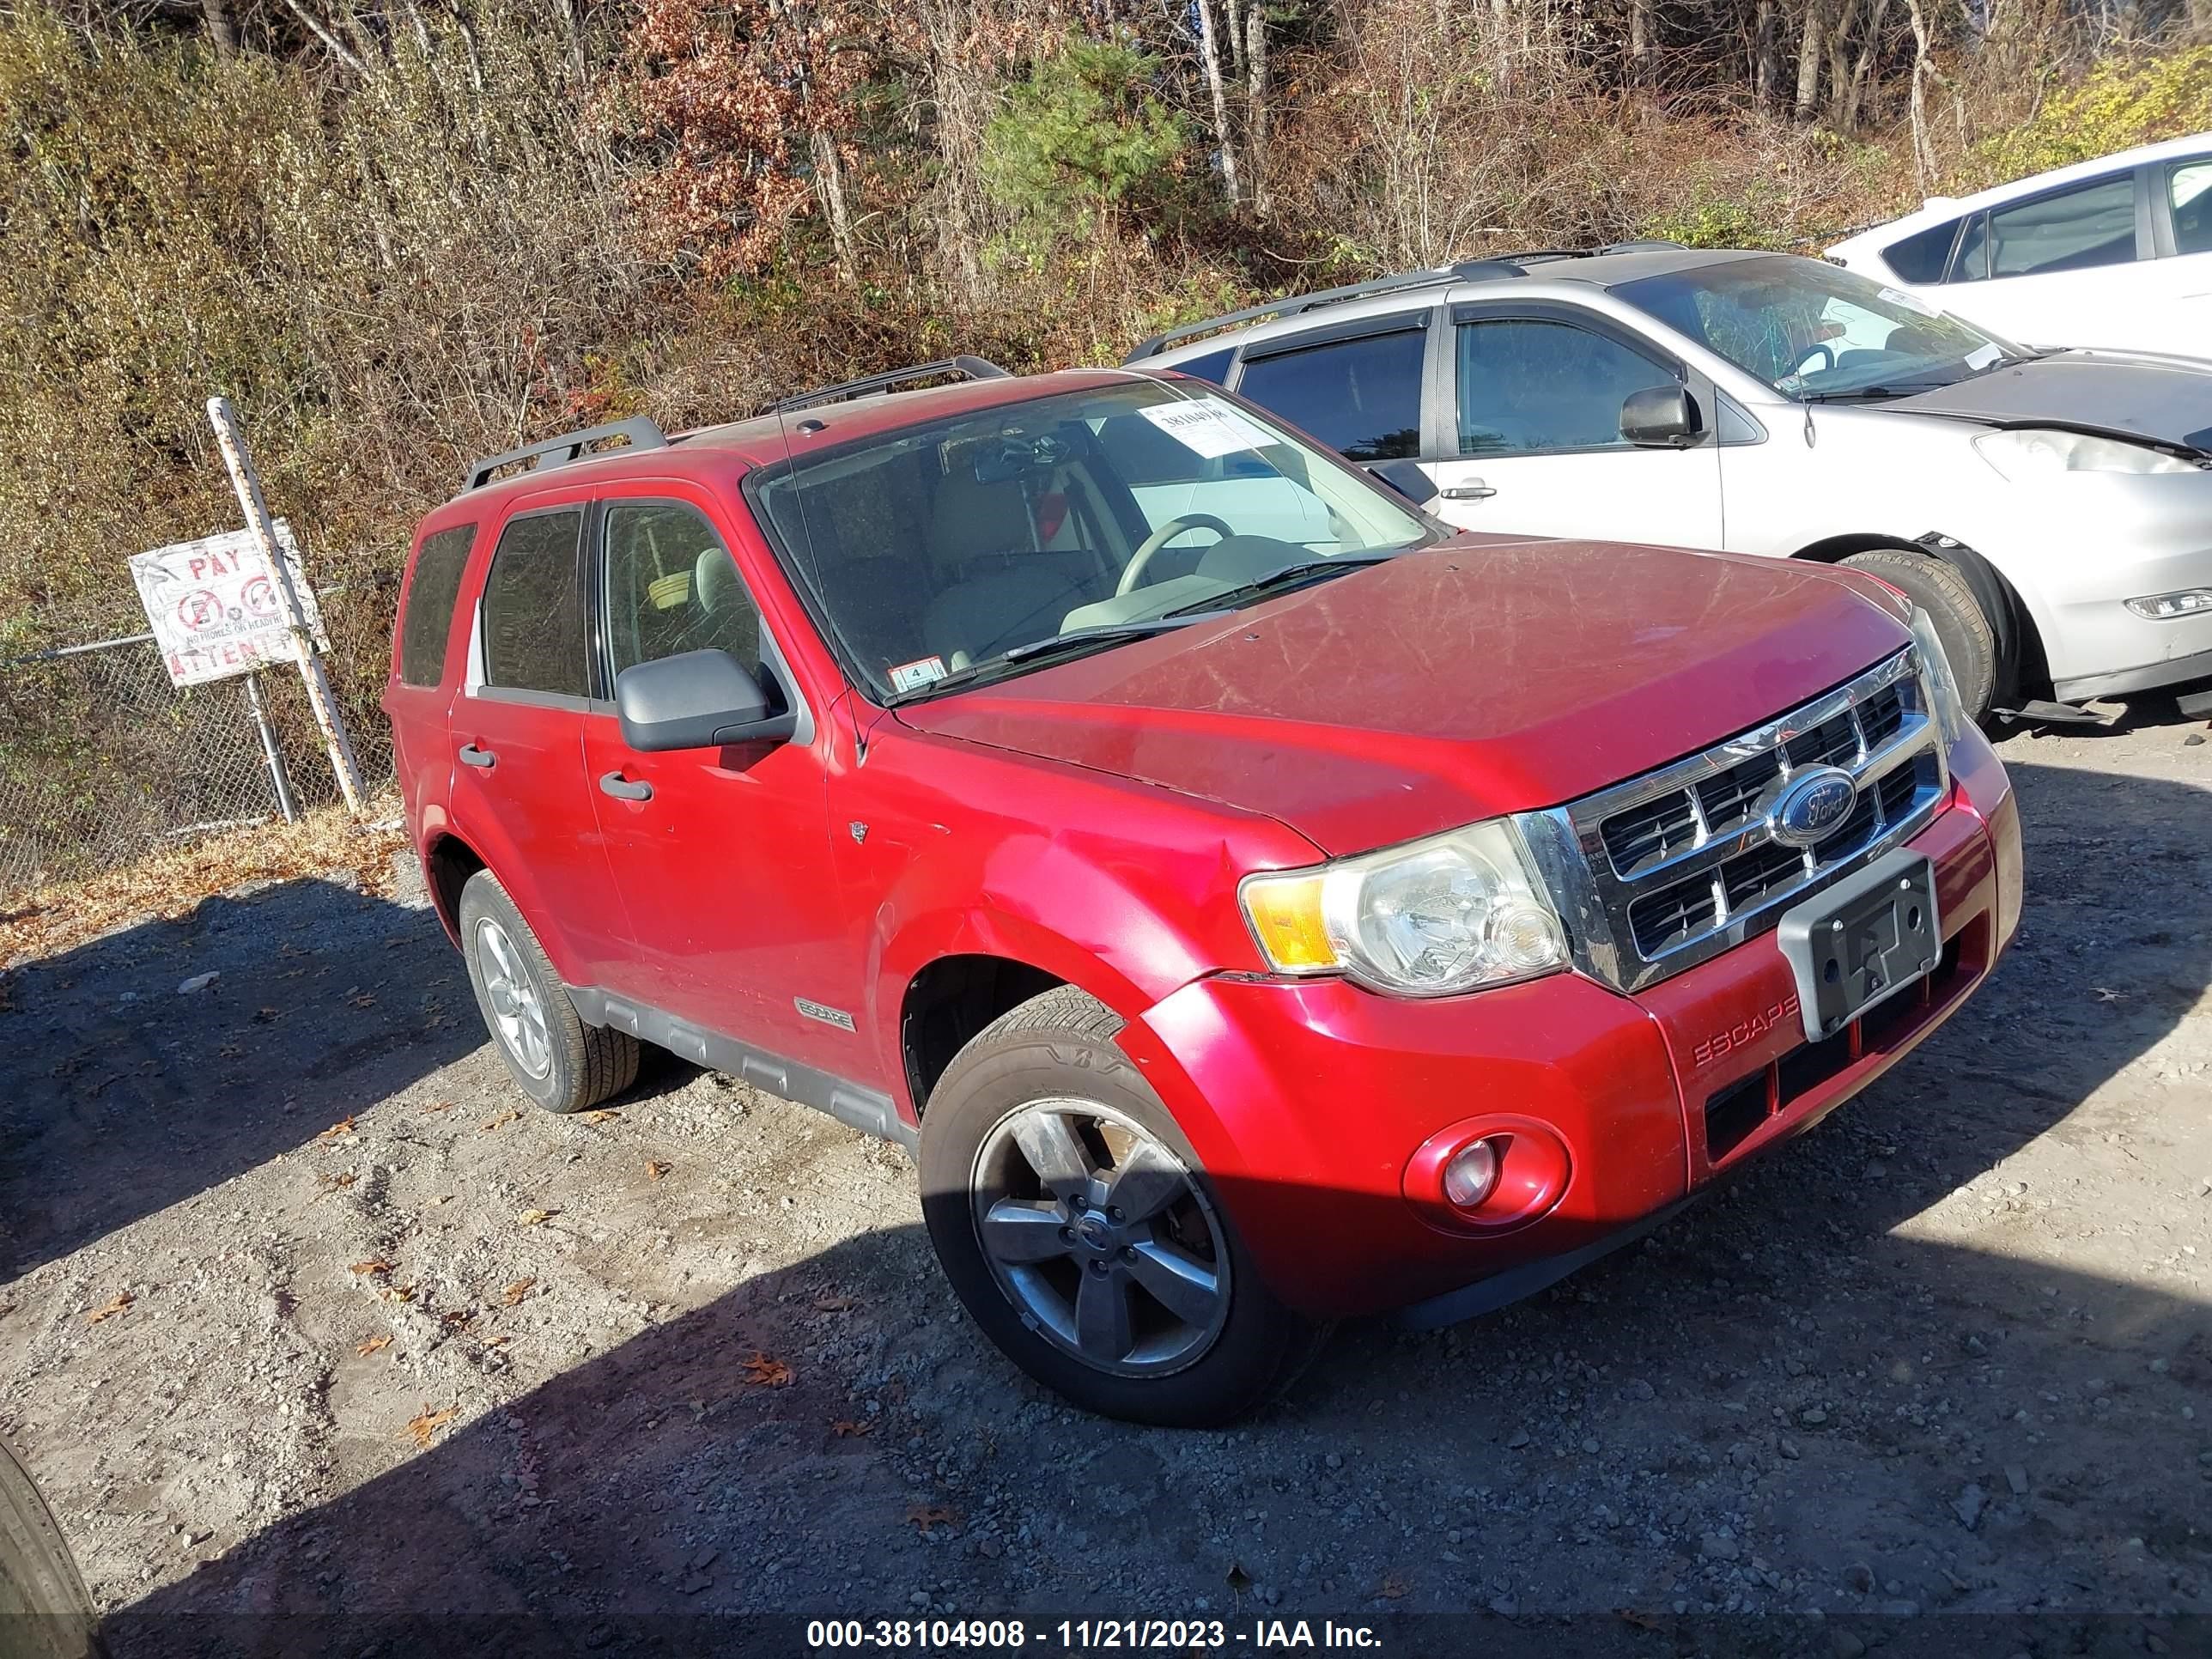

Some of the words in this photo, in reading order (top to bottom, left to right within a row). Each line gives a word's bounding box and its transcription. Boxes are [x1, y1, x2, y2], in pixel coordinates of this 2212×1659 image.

[188, 549, 240, 580] PAY
[186, 635, 199, 645] NO
[1808, 787, 1845, 826] Ford
[1693, 992, 1800, 1067] ESCAPE
